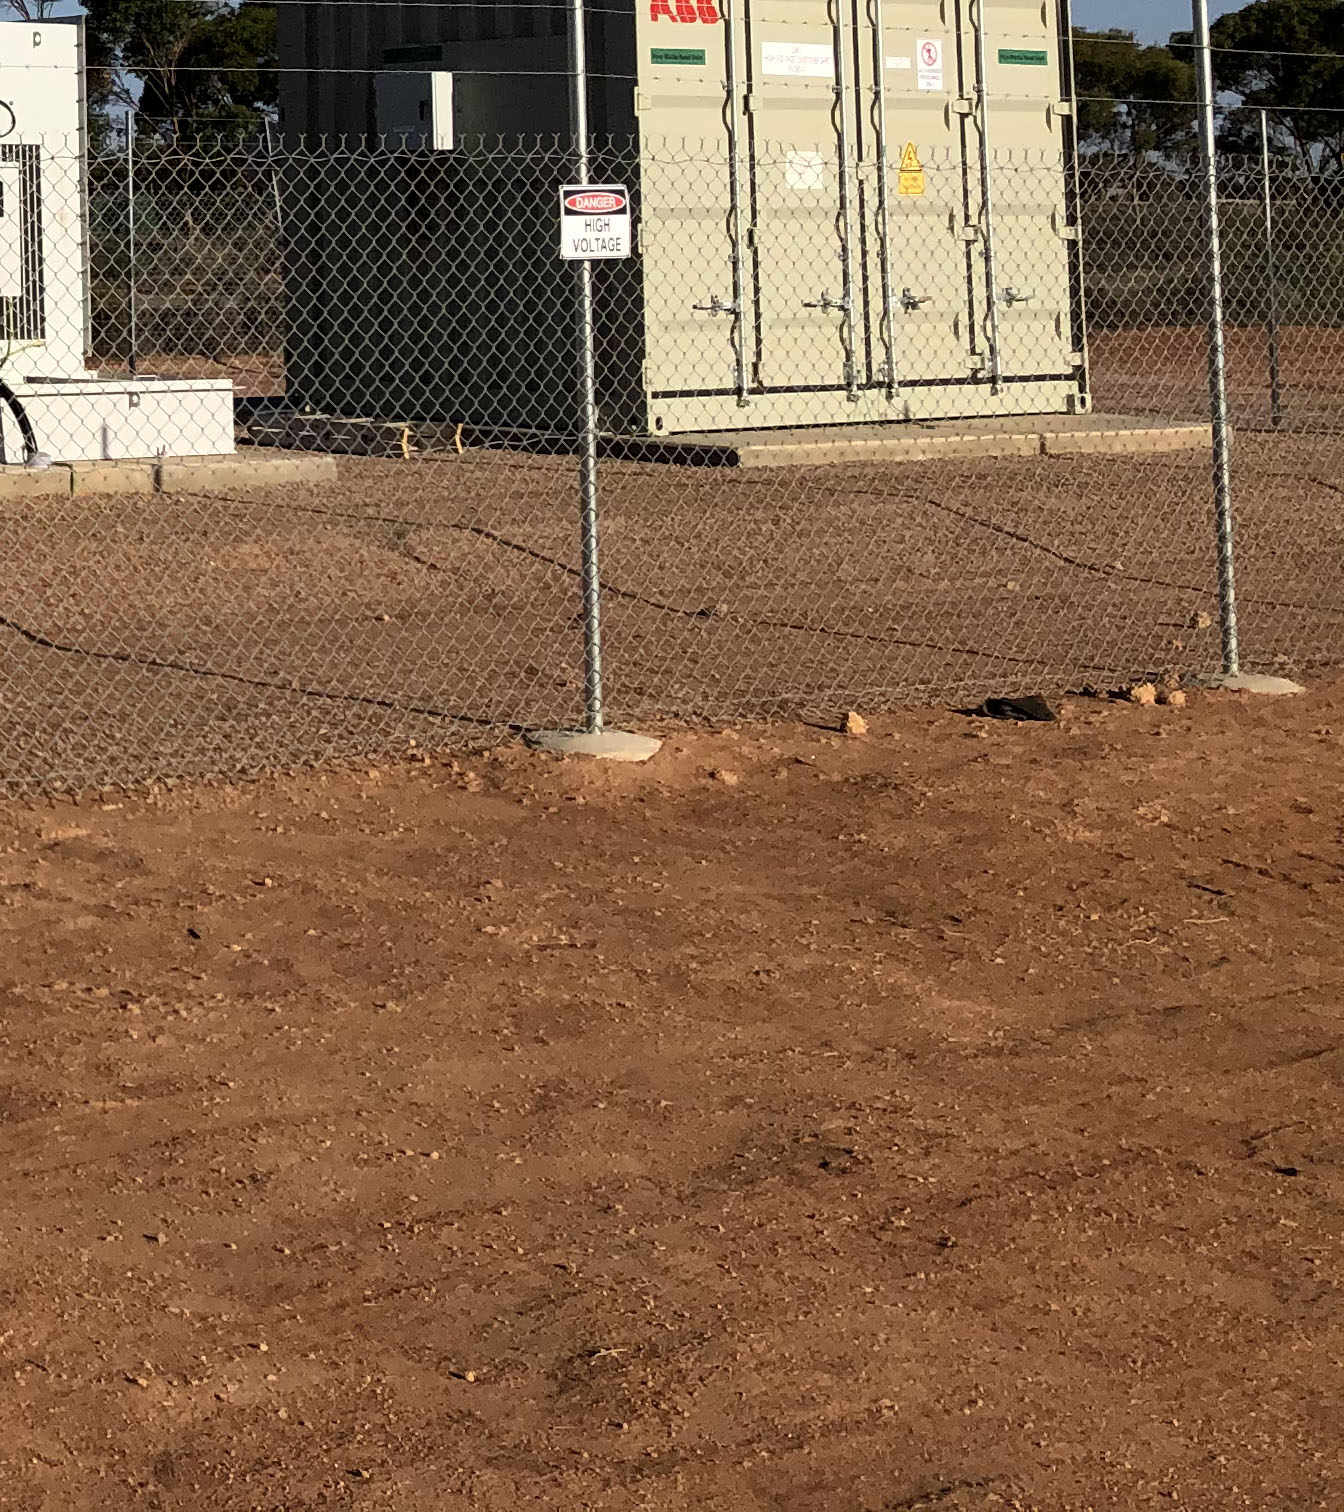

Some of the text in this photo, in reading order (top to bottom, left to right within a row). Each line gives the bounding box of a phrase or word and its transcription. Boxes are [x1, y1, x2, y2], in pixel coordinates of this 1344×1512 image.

[576, 196, 617, 209] DANGER
[584, 217, 611, 233] HIGH
[572, 237, 622, 253] VOLTAGE
